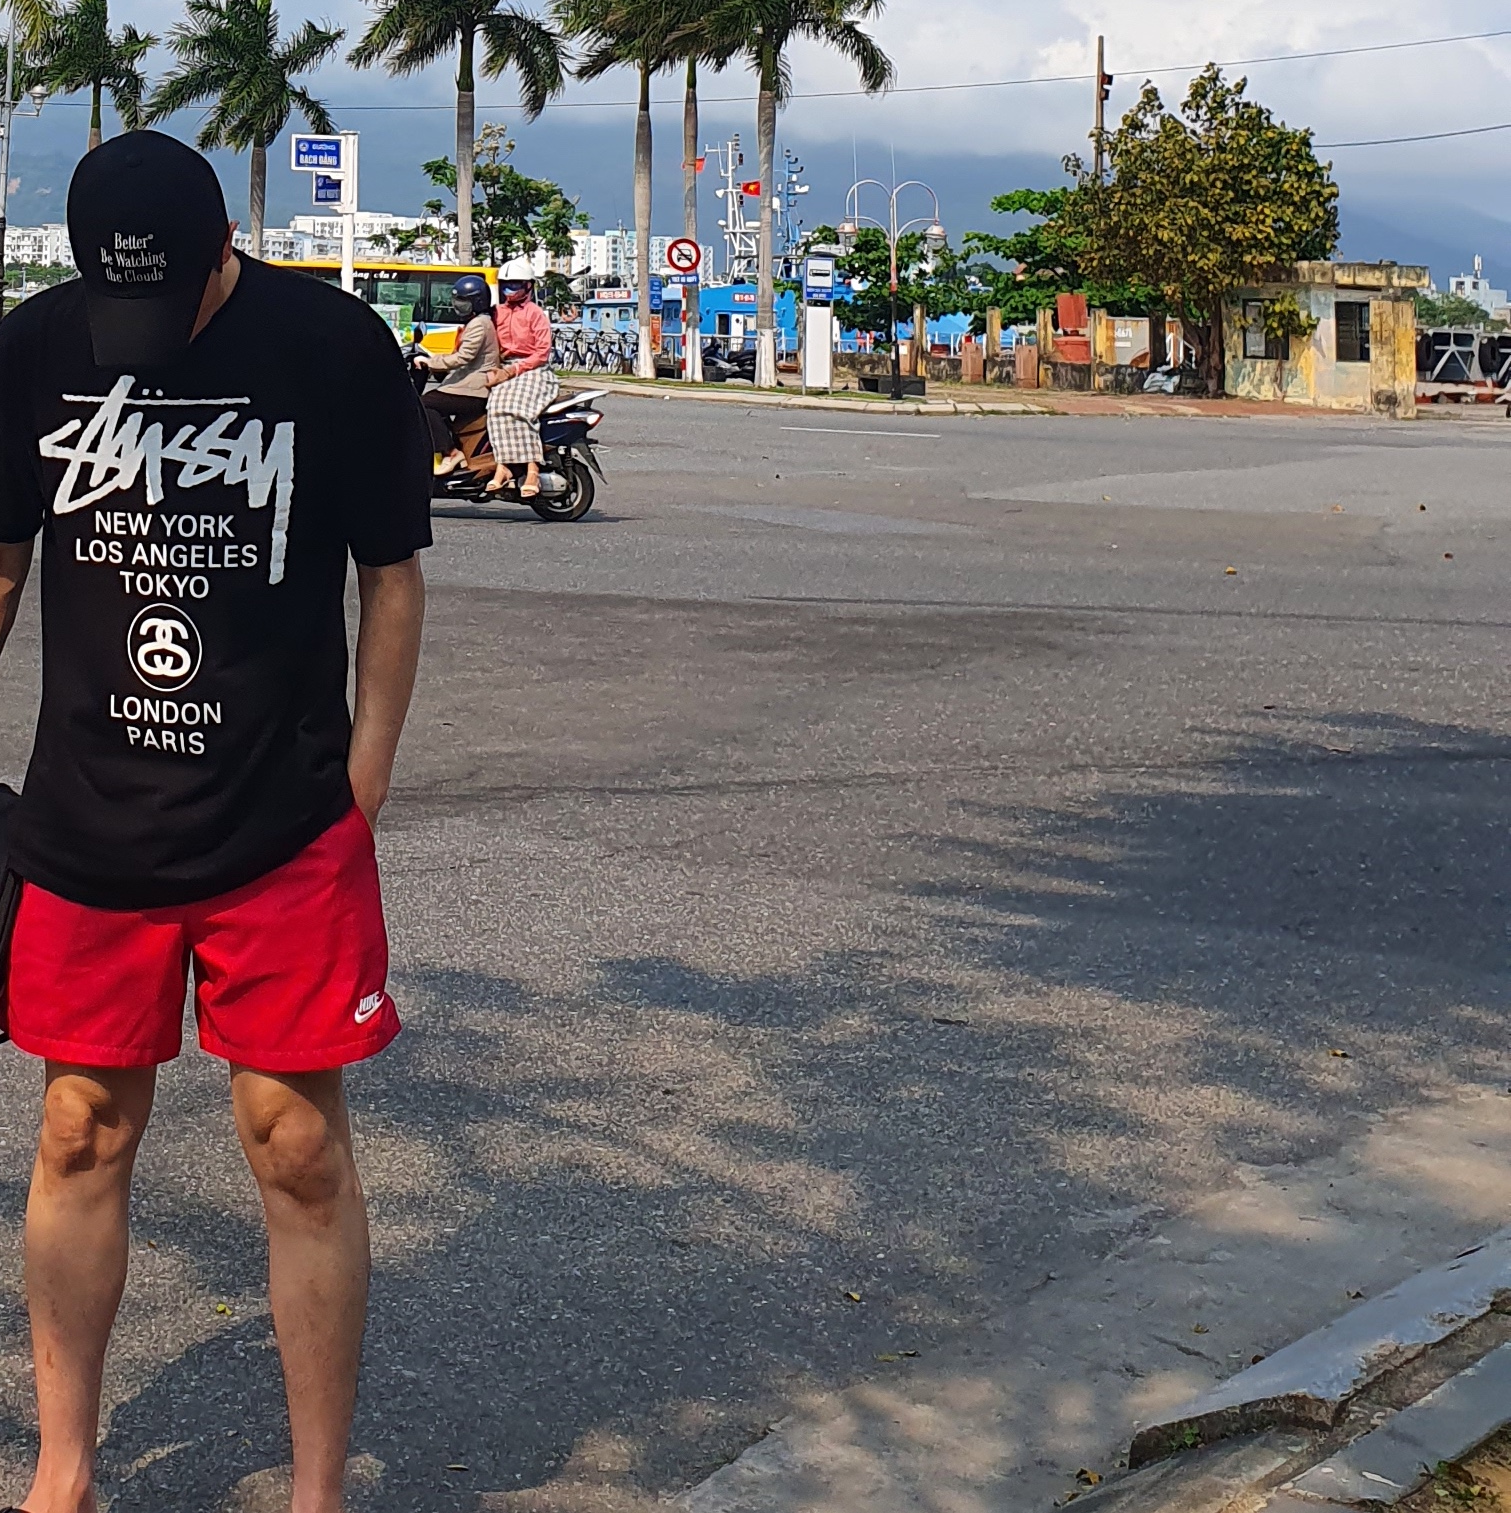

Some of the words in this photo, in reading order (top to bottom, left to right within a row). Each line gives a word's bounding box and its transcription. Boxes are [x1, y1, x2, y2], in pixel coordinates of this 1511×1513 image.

[100, 246, 113, 265] Be
[114, 251, 167, 268] Watching
[106, 267, 123, 283] the
[124, 267, 164, 283] Clouds
[95, 510, 152, 536] NEW
[160, 514, 235, 538] YORK
[75, 538, 123, 564] LOS
[131, 543, 258, 568] ANGELES
[119, 570, 210, 599] TOKYO
[110, 694, 222, 725] LONDON
[126, 725, 205, 755] PARIS
[359, 990, 380, 1013] NIKE
